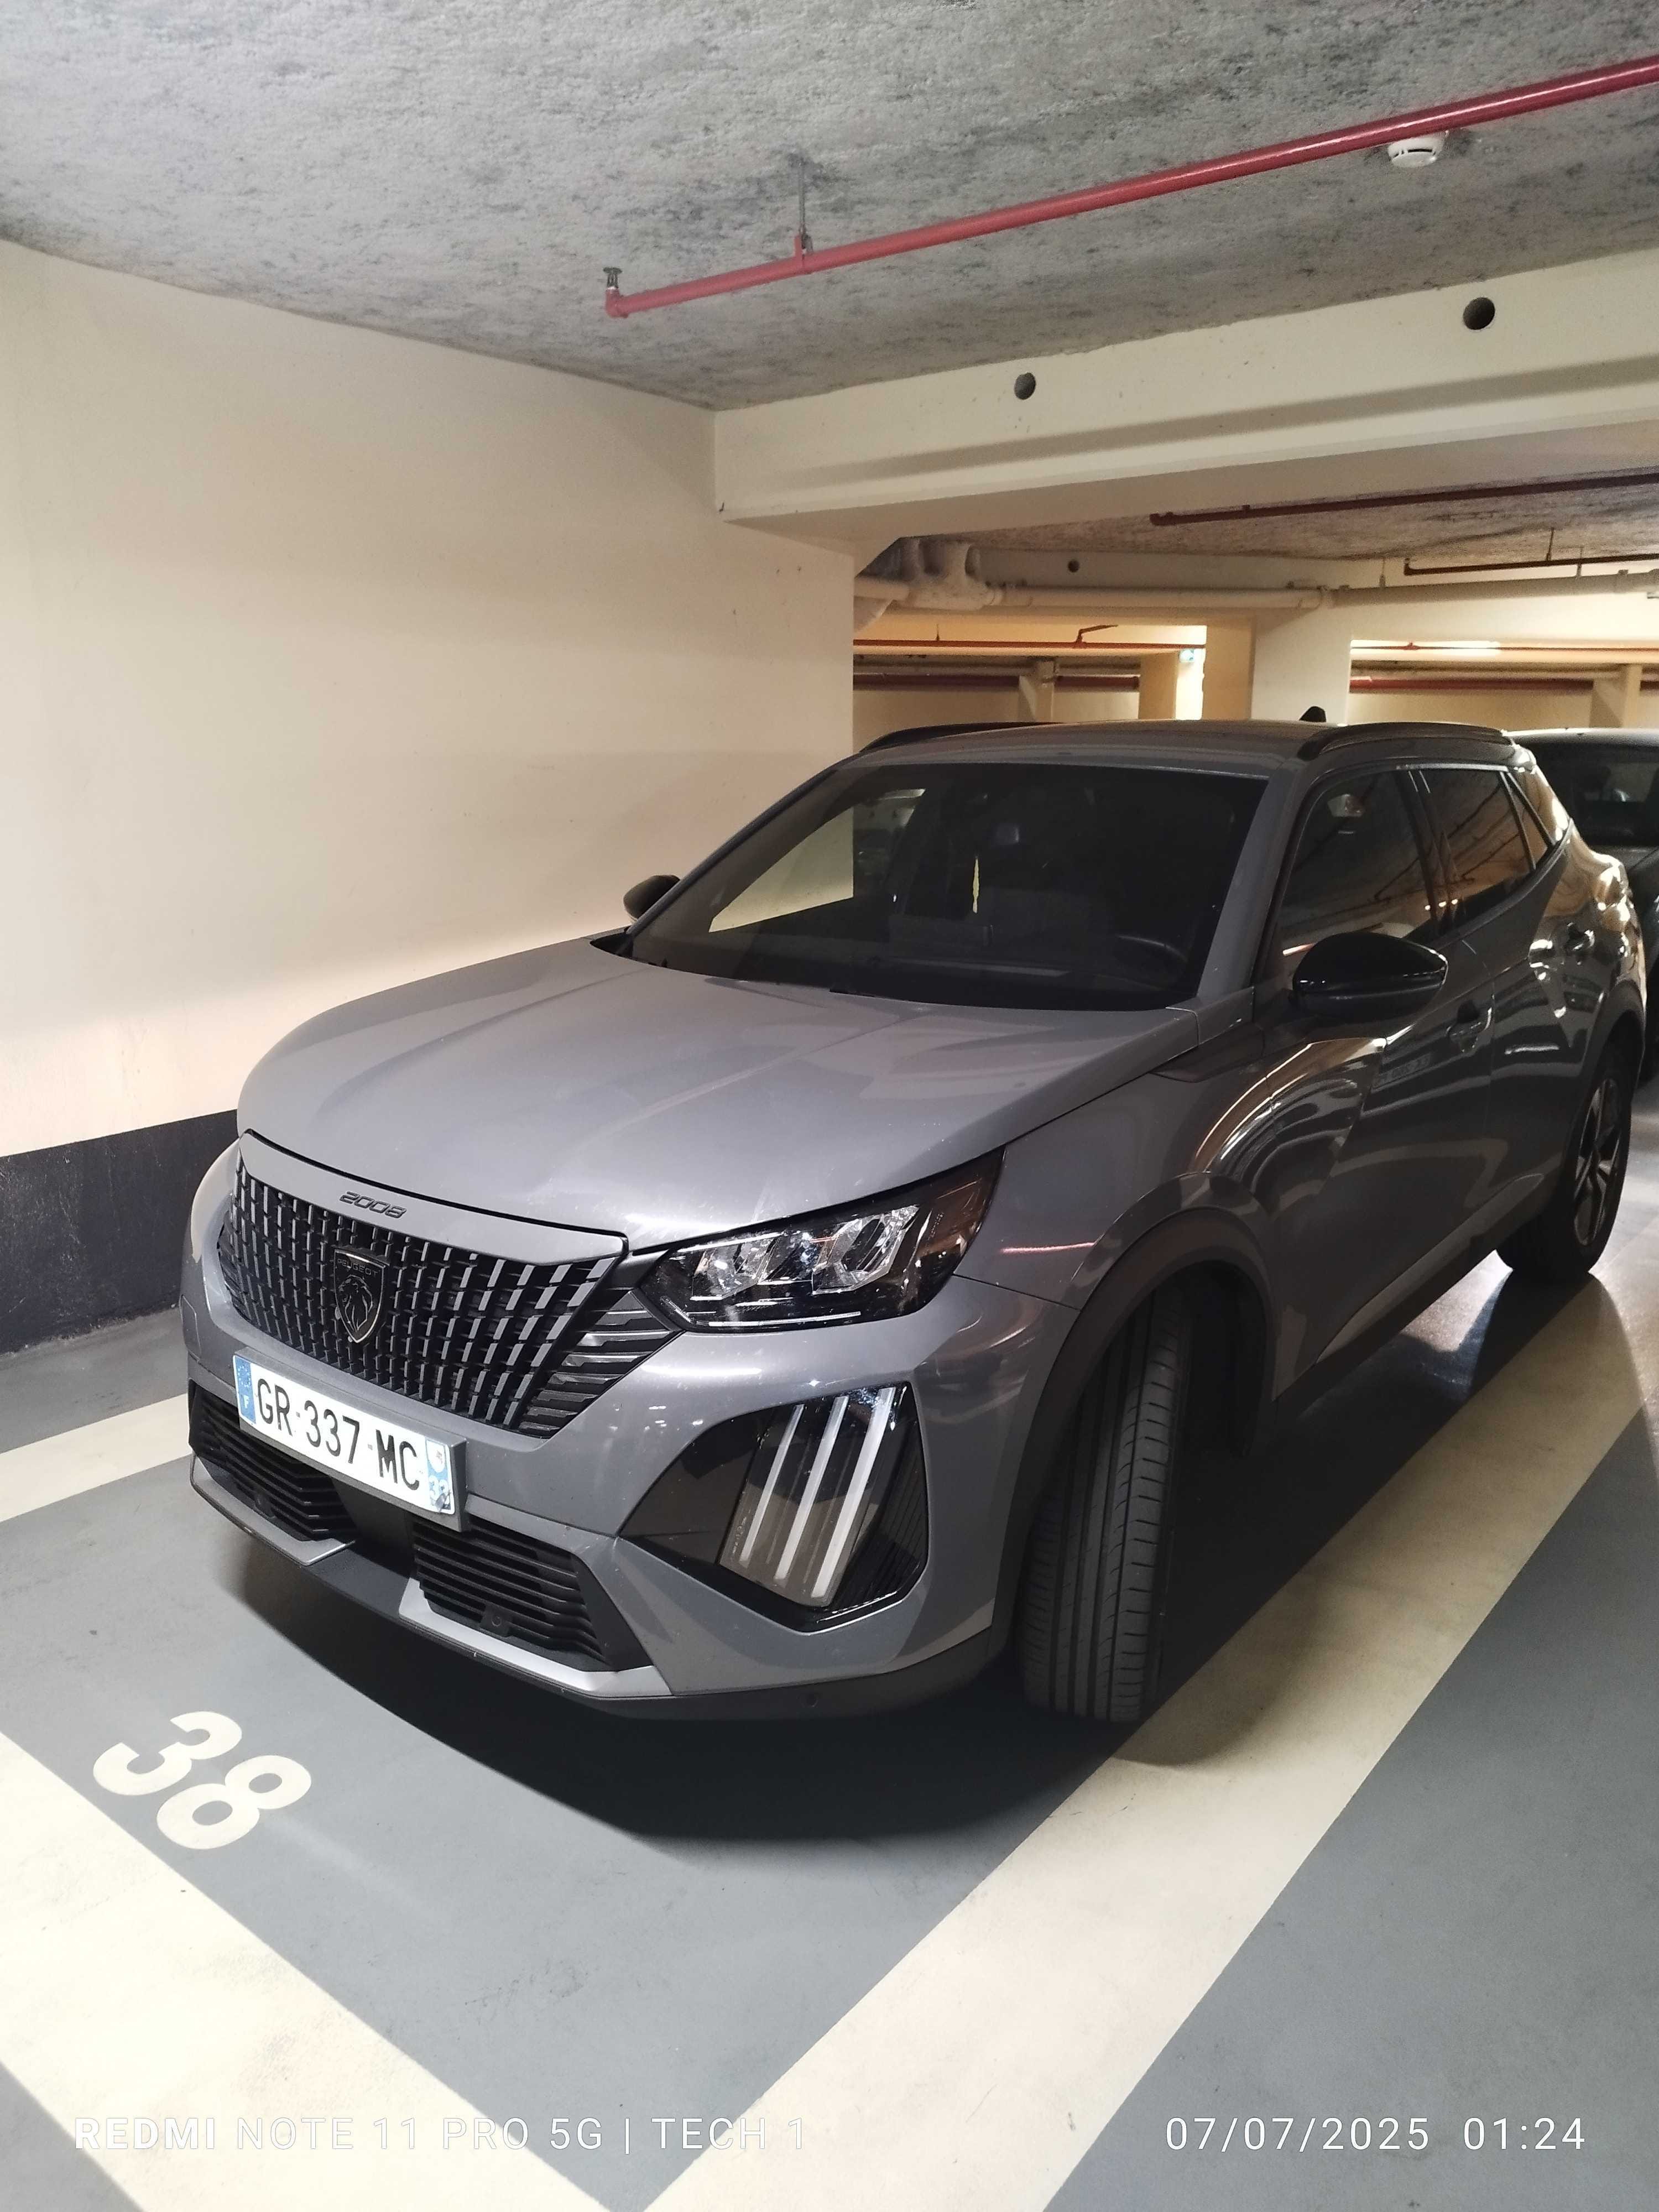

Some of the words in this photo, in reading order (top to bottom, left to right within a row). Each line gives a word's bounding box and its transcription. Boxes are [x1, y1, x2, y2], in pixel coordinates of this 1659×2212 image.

[339, 1191, 407, 1218] 2008
[337, 1258, 378, 1276] PEUGEOT
[243, 1394, 249, 1408] F
[93, 1711, 311, 1849] 38
